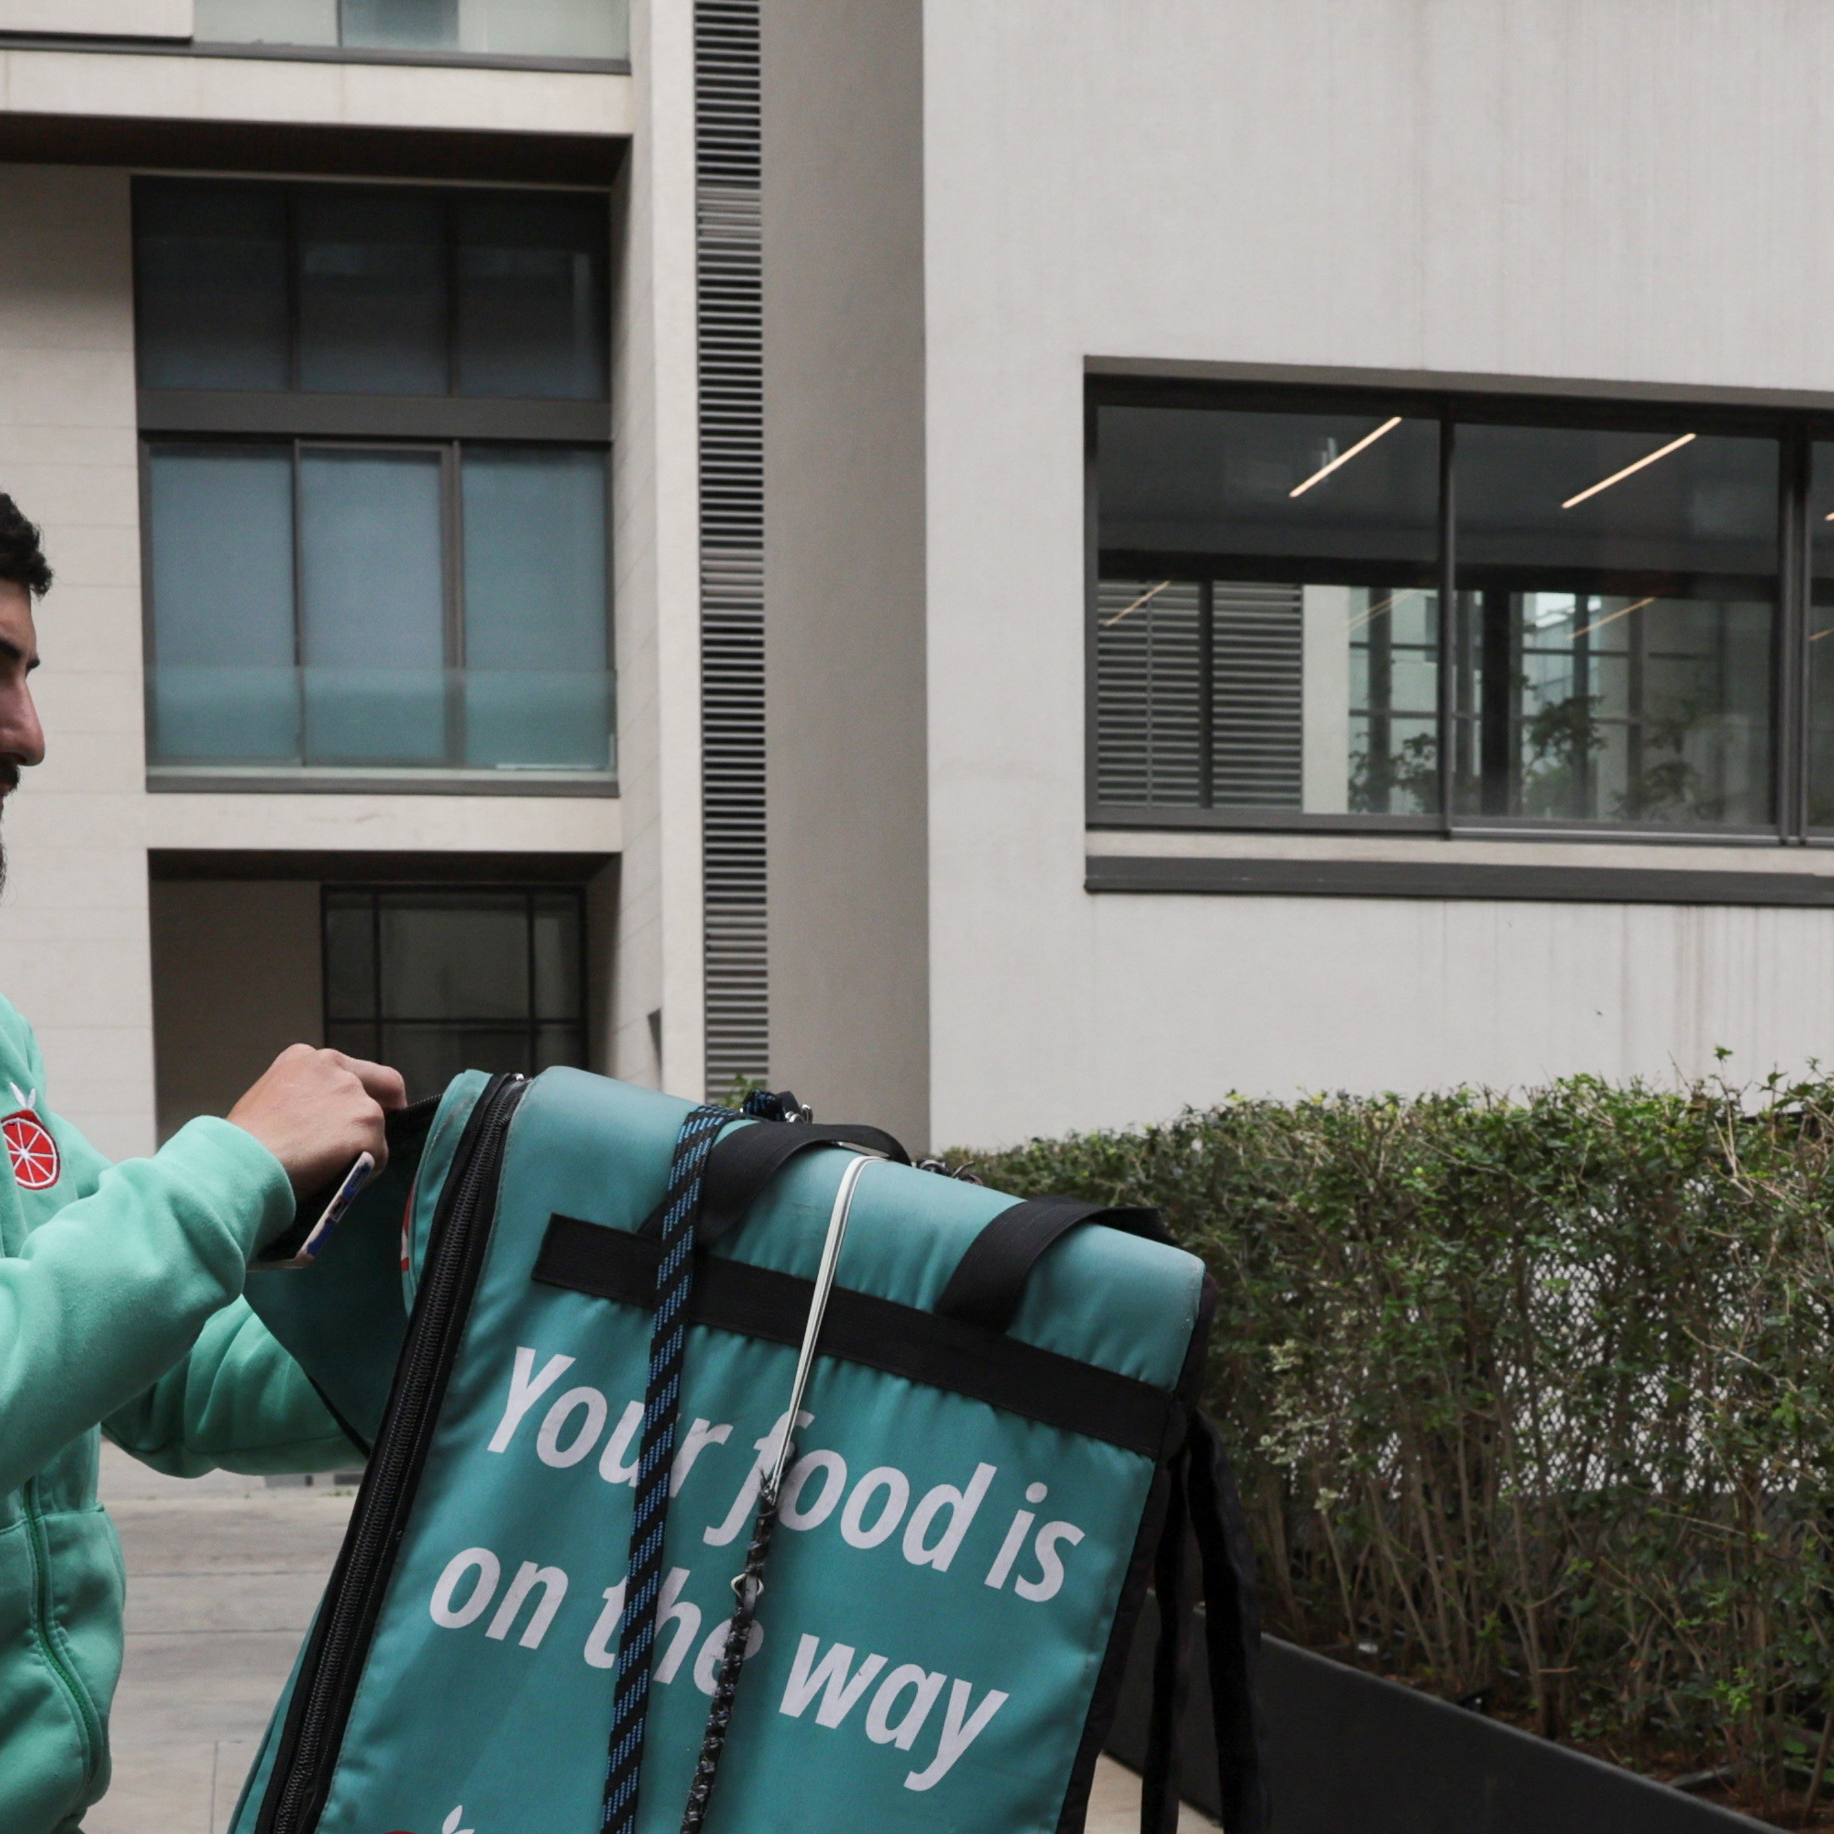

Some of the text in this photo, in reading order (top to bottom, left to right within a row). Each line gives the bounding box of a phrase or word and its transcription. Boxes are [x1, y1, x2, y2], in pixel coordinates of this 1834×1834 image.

[487, 1345, 1086, 1603] Your food is
[429, 1546, 1010, 1792] on the way
